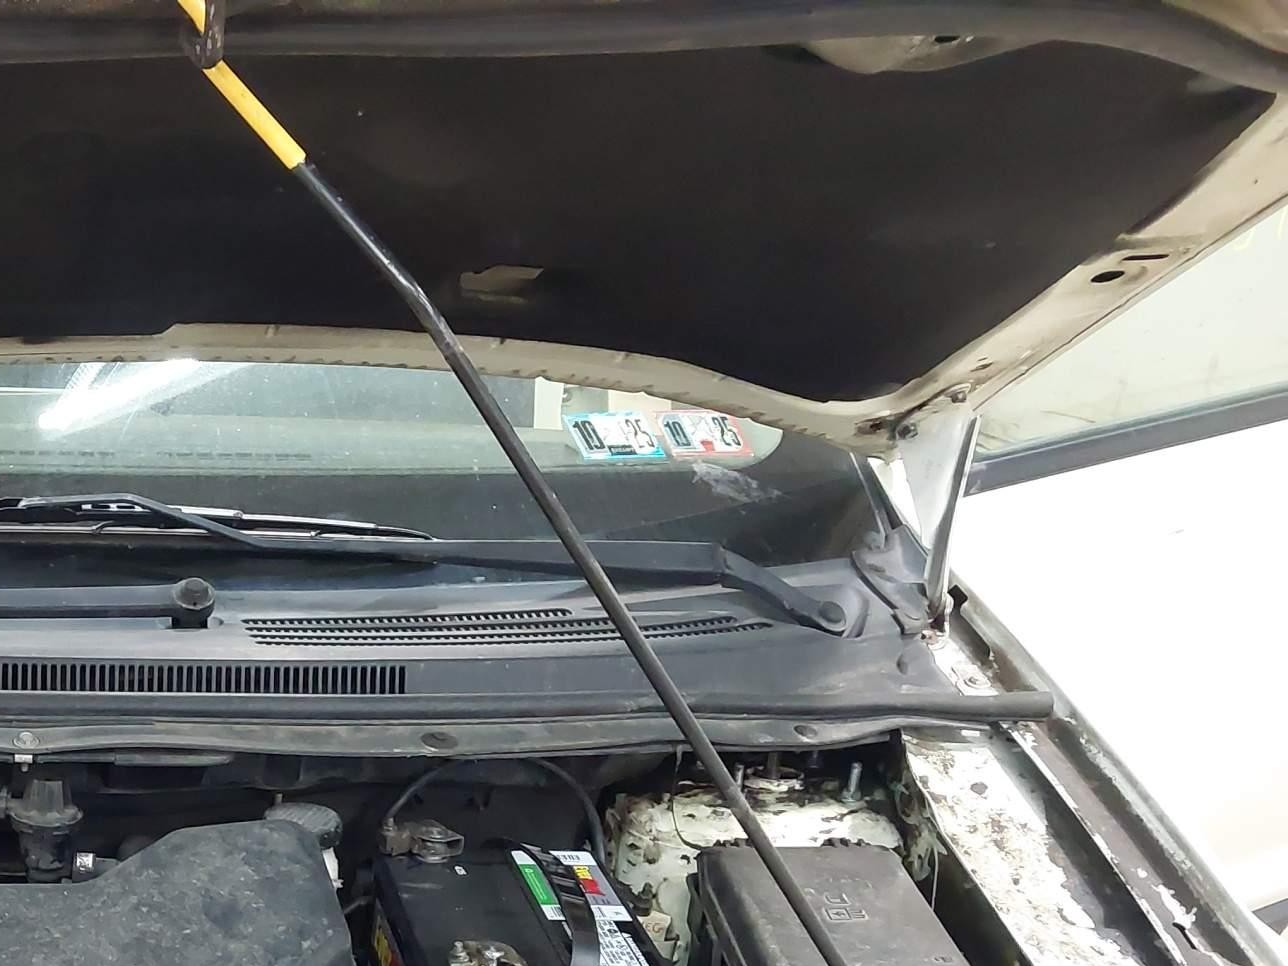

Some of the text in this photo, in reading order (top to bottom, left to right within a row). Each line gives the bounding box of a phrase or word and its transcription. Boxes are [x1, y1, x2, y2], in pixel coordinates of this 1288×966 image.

[573, 418, 655, 450] 10 25
[664, 416, 741, 447] 10 25
